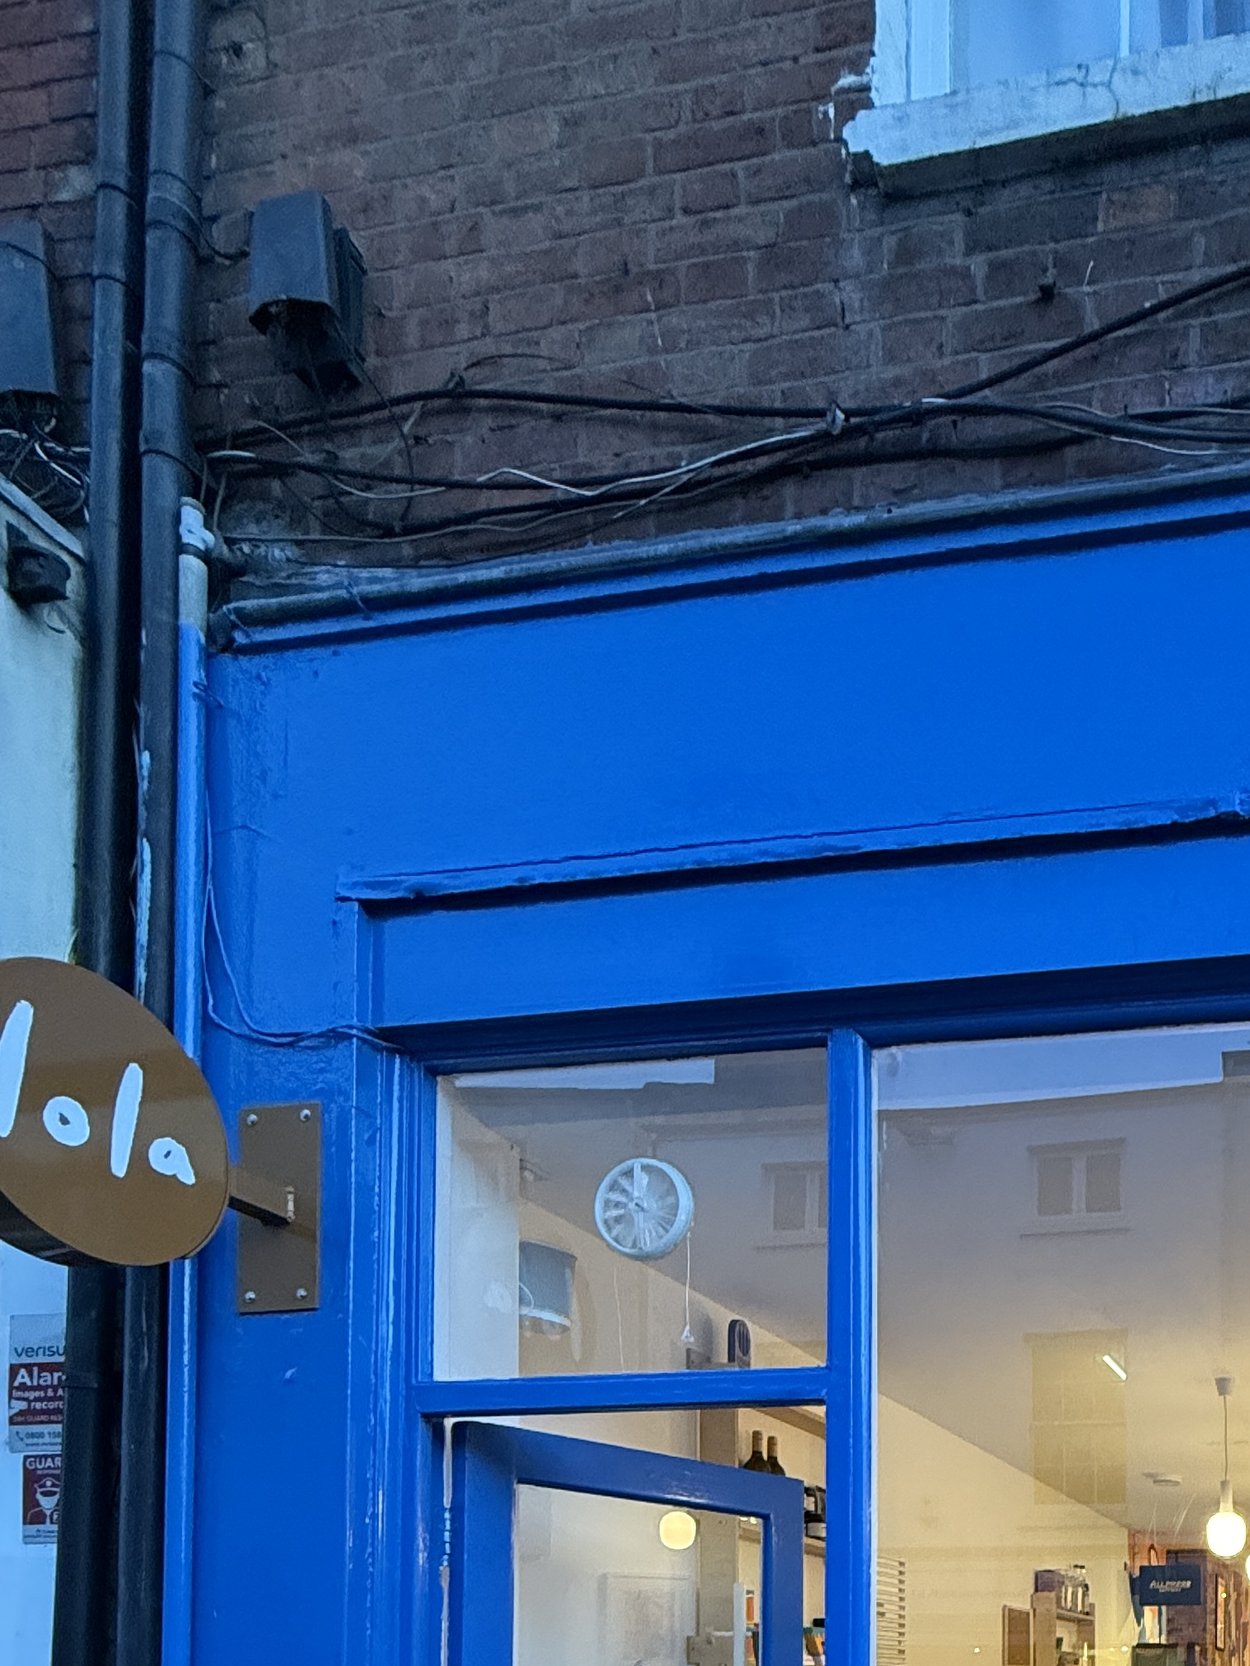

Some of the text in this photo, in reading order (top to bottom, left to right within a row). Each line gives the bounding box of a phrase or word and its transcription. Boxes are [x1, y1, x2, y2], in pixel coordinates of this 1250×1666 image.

[0, 1000, 196, 1185] lola
[13, 1367, 66, 1387] Alar
[12, 1389, 45, 1400] Images
[47, 1388, 54, 1397] &
